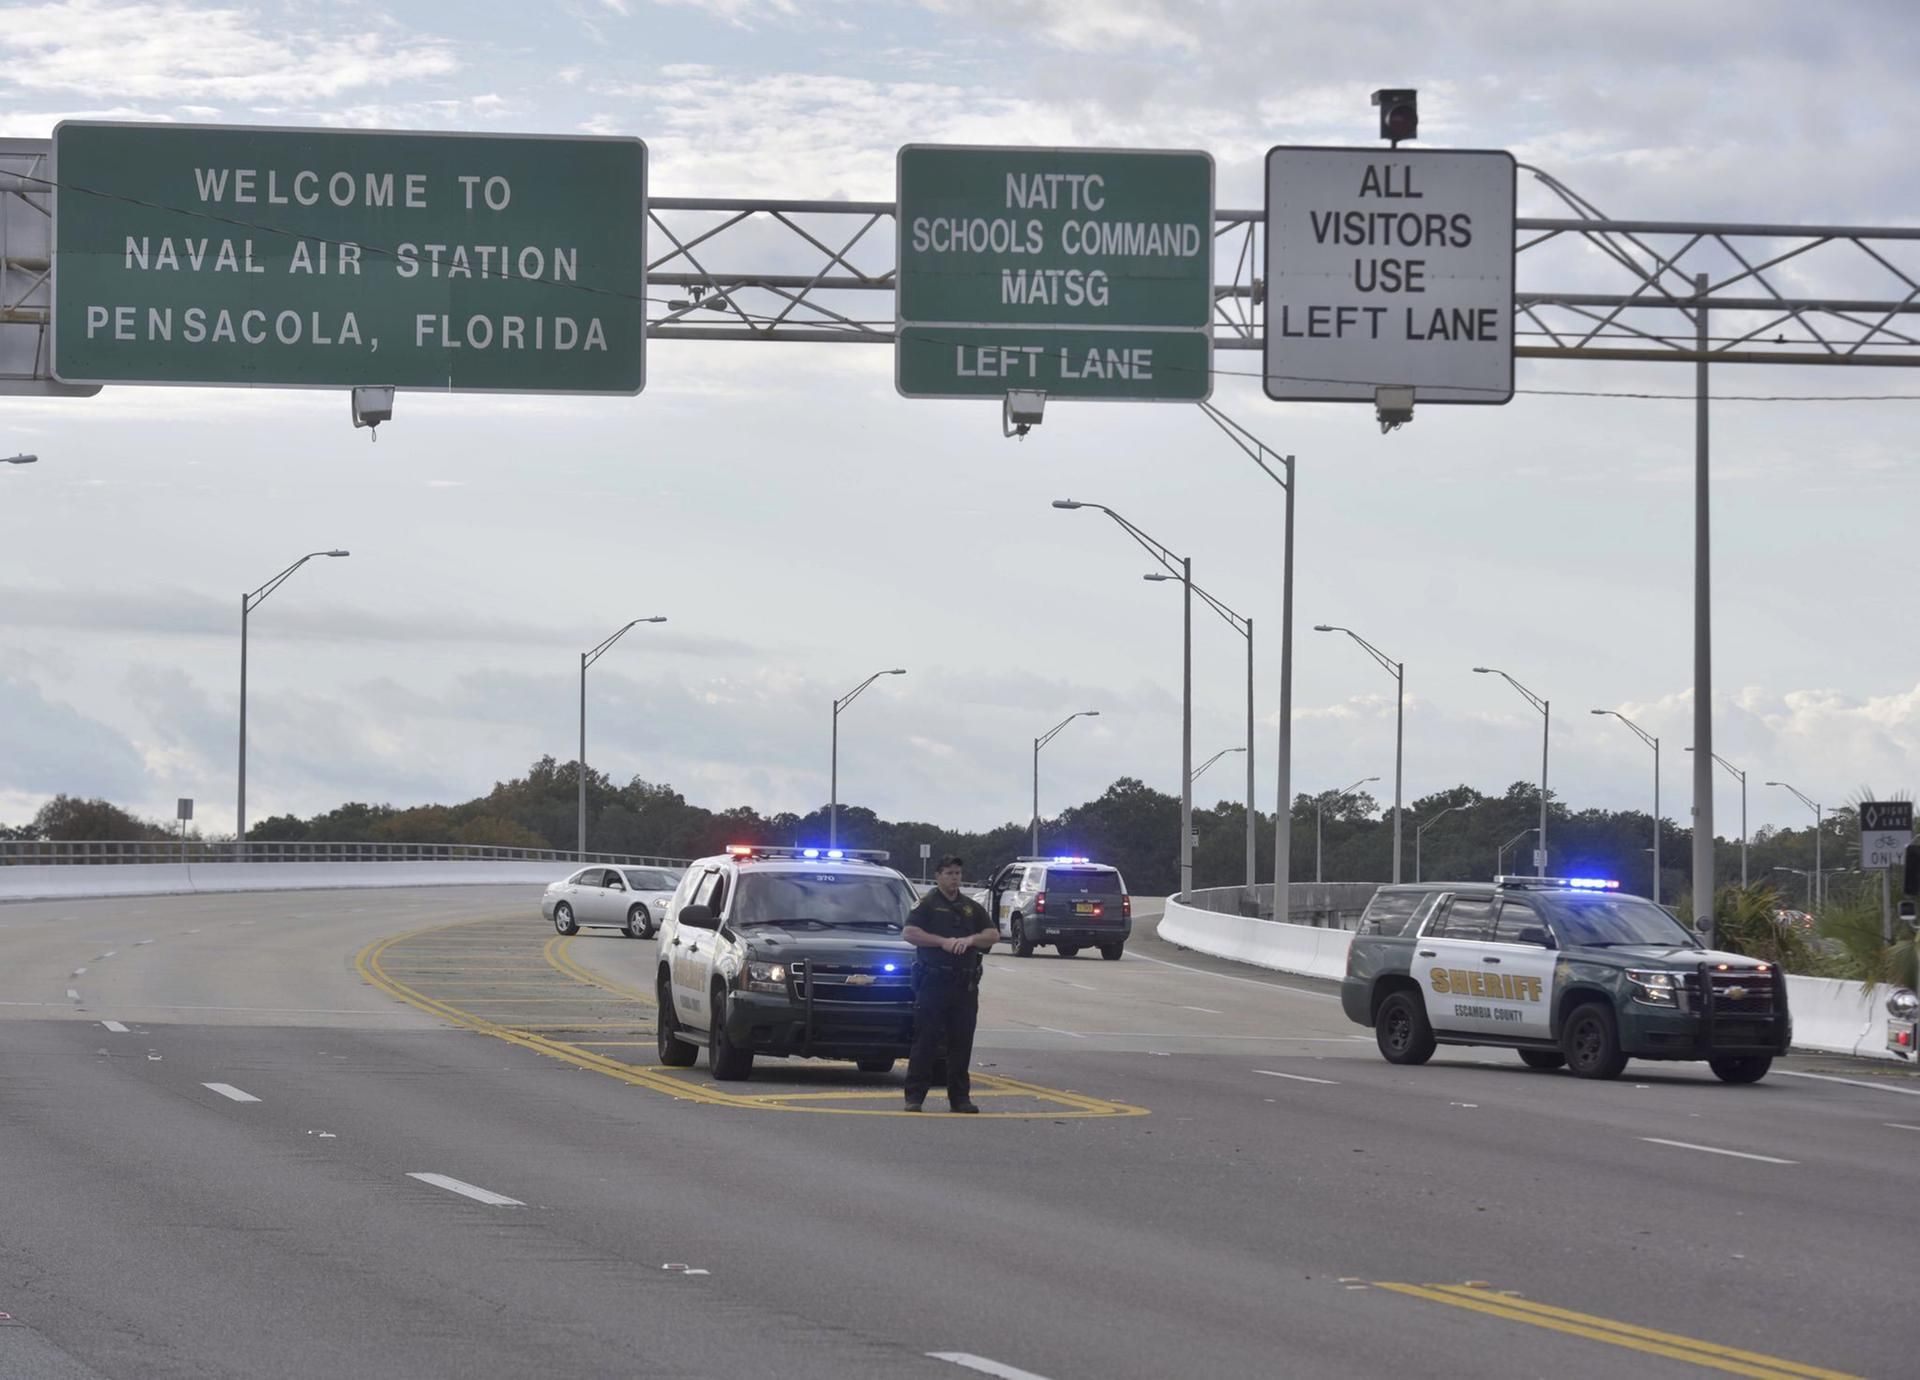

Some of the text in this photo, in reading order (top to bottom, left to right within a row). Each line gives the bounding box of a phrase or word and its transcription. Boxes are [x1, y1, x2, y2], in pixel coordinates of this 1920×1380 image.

[194, 168, 511, 211] WELCOME TO
[1006, 172, 1105, 212] NATTC
[1359, 164, 1423, 199] ALL
[913, 217, 1200, 257] SCHOOLS COMMAND
[1310, 210, 1472, 249] VISITORS
[125, 236, 577, 281] NAVAL AIR STATION
[1354, 258, 1425, 293] USE
[1002, 268, 1109, 307] MATSG
[87, 305, 607, 353] PENSACOLA, FLORIDA
[1282, 305, 1498, 342] LEFT LANE
[957, 345, 1153, 380] LEFT LANE
[1882, 818, 1908, 826] LANE
[1871, 852, 1904, 865] ONLY
[1430, 967, 1543, 1002] SHERIFF
[1454, 1004, 1523, 1021] ESCAMBIA COUNTY
